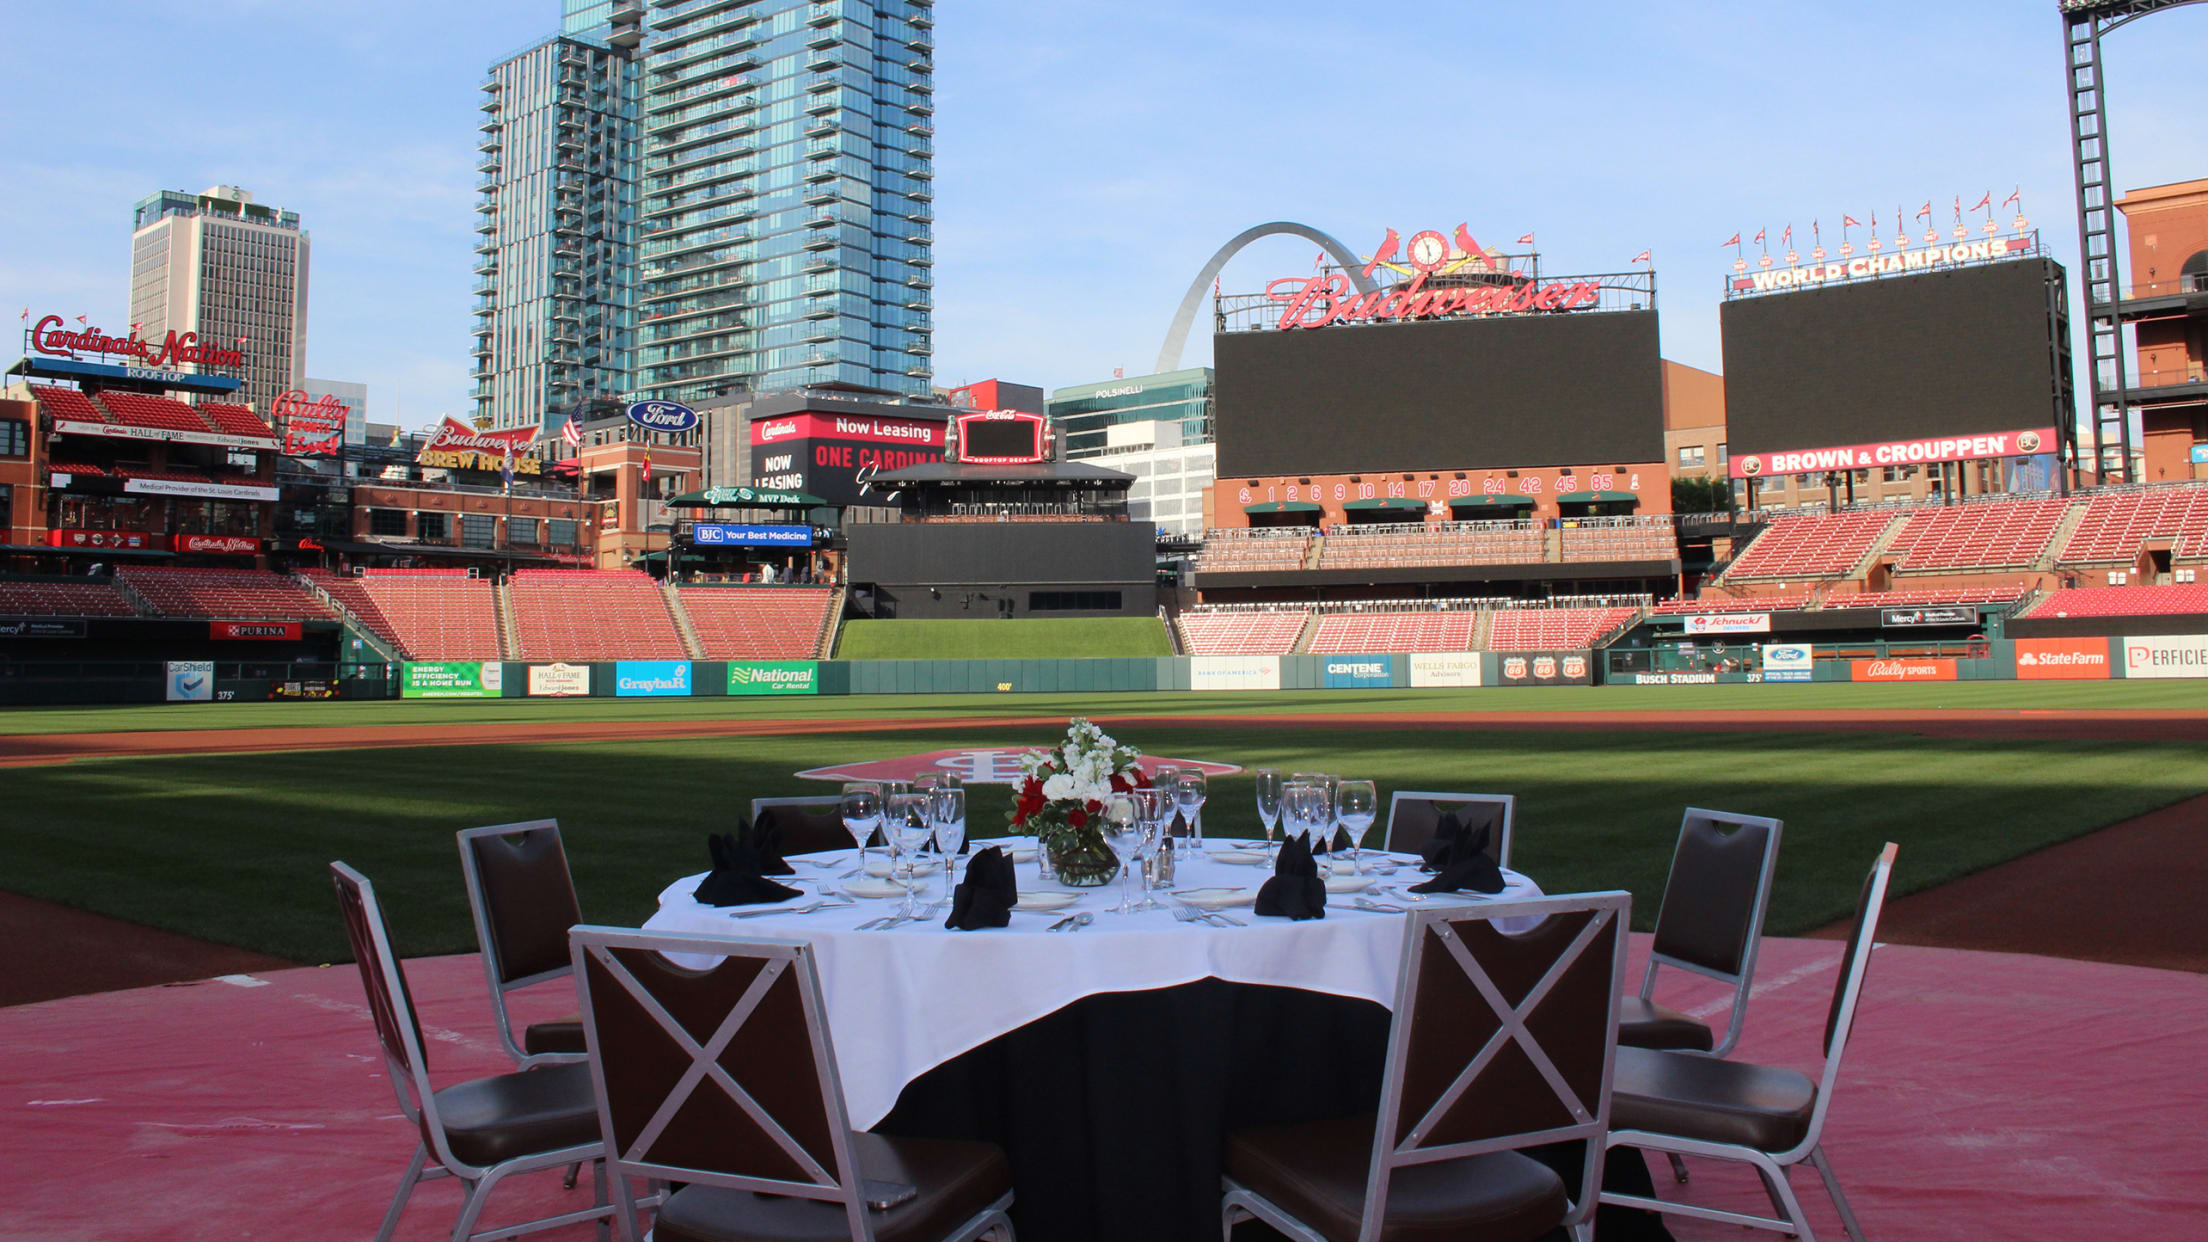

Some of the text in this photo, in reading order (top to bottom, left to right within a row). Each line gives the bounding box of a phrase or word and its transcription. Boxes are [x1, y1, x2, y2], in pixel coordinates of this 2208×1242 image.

[1753, 239, 2009, 290] WORLD CHAMPIONS
[1266, 270, 1600, 331] Budweiser
[32, 314, 243, 368] Cardinals Nation
[127, 367, 186, 383] ROOFTOP
[1095, 384, 1143, 399] POLSINELLI
[272, 390, 352, 429] Bally
[643, 403, 686, 426] Ford
[290, 419, 331, 434] SPORTS
[761, 421, 797, 440] Cardinals
[836, 417, 932, 443] Now Leasing
[130, 428, 153, 439] HALL
[161, 430, 184, 441] FAME
[815, 446, 945, 470] ONE CARDINA
[1772, 436, 2005, 473] BROWN & CROUPPEN
[420, 449, 542, 475] BREW HOUSE
[765, 455, 792, 472] NOW
[1268, 486, 1275, 501] 1
[1287, 486, 1297, 501] 2
[1311, 485, 1321, 500] 6
[1335, 484, 1345, 499] 9
[1359, 483, 1375, 499] 10
[1387, 482, 1404, 498] 14
[1418, 481, 1435, 497] 17
[1449, 479, 1470, 496] 20
[1483, 478, 1505, 495] 24
[1519, 476, 1542, 494] 42
[1554, 475, 1577, 492] 45
[1590, 474, 1613, 491] 85
[758, 495, 800, 503] MVP Deck
[701, 529, 808, 541] BJC Your Best Medicine
[1709, 615, 1765, 626] Schnucks
[1891, 614, 1915, 624] Mercy
[0, 623, 20, 635] ercy
[241, 626, 285, 636] PURINA
[168, 662, 212, 672] CarShield
[1328, 663, 1383, 674] CENTENE
[1414, 661, 1477, 671] WELLS FARGO
[1508, 666, 1522, 675] 66
[1537, 665, 1550, 674] 66
[1567, 665, 1580, 674] 66
[1868, 661, 1937, 680] Bally SPORTS
[538, 671, 556, 679] HALL
[562, 671, 581, 679] FAME
[750, 668, 812, 682] National
[1636, 674, 1716, 684] BUSCH STADIUM
